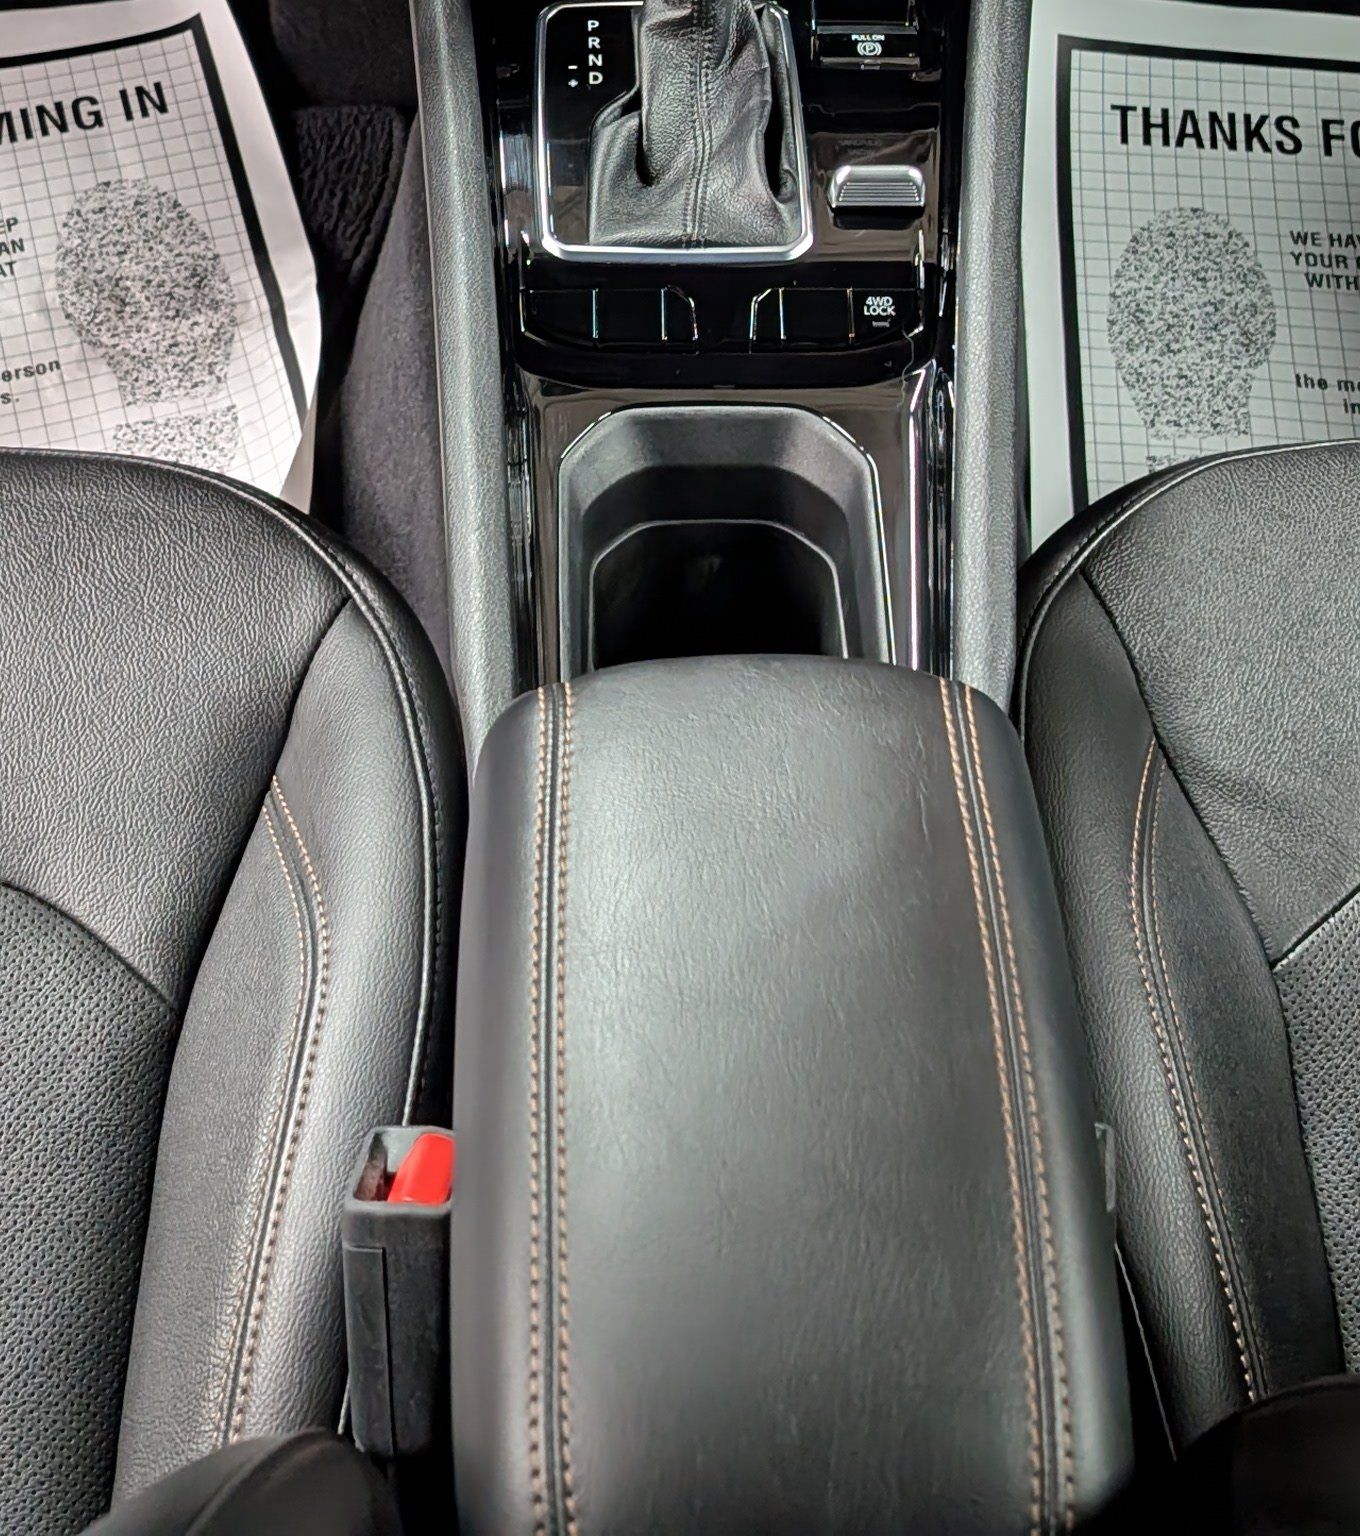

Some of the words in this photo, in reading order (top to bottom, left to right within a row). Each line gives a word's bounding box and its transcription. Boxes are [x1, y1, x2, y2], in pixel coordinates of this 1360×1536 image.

[587, 20, 600, 32] P
[588, 36, 601, 49] R
[588, 53, 603, 67] N
[589, 71, 603, 85] D
[119, 81, 169, 122] IN
[1110, 104, 1303, 156] THANKS
[1290, 230, 1322, 247] WE
[1290, 251, 1349, 269] YOUR
[1304, 272, 1360, 291] WITH
[865, 296, 894, 306] 4WD
[863, 305, 896, 316] LOCK
[1295, 372, 1328, 390] the
